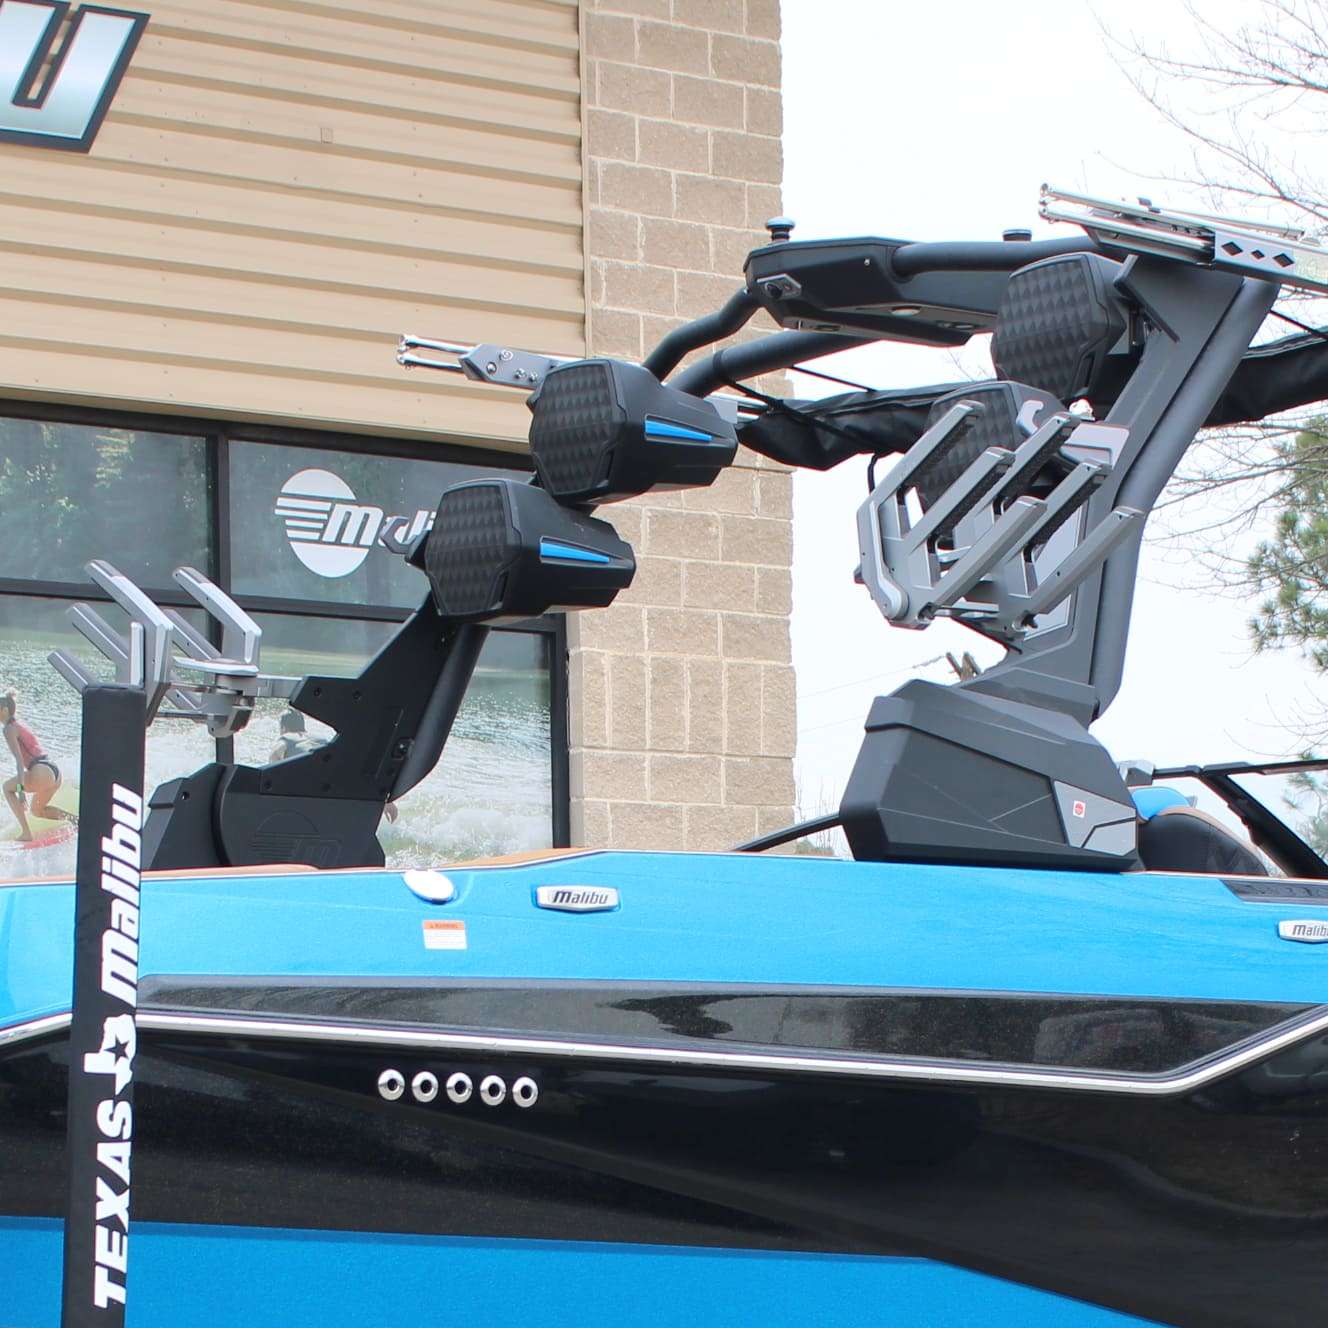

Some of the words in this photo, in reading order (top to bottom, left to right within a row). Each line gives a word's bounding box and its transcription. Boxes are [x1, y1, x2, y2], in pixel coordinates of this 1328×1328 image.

[101, 782, 144, 1006] Malibu
[551, 889, 609, 905] Malibu
[94, 1099, 135, 1309] TEXAS
